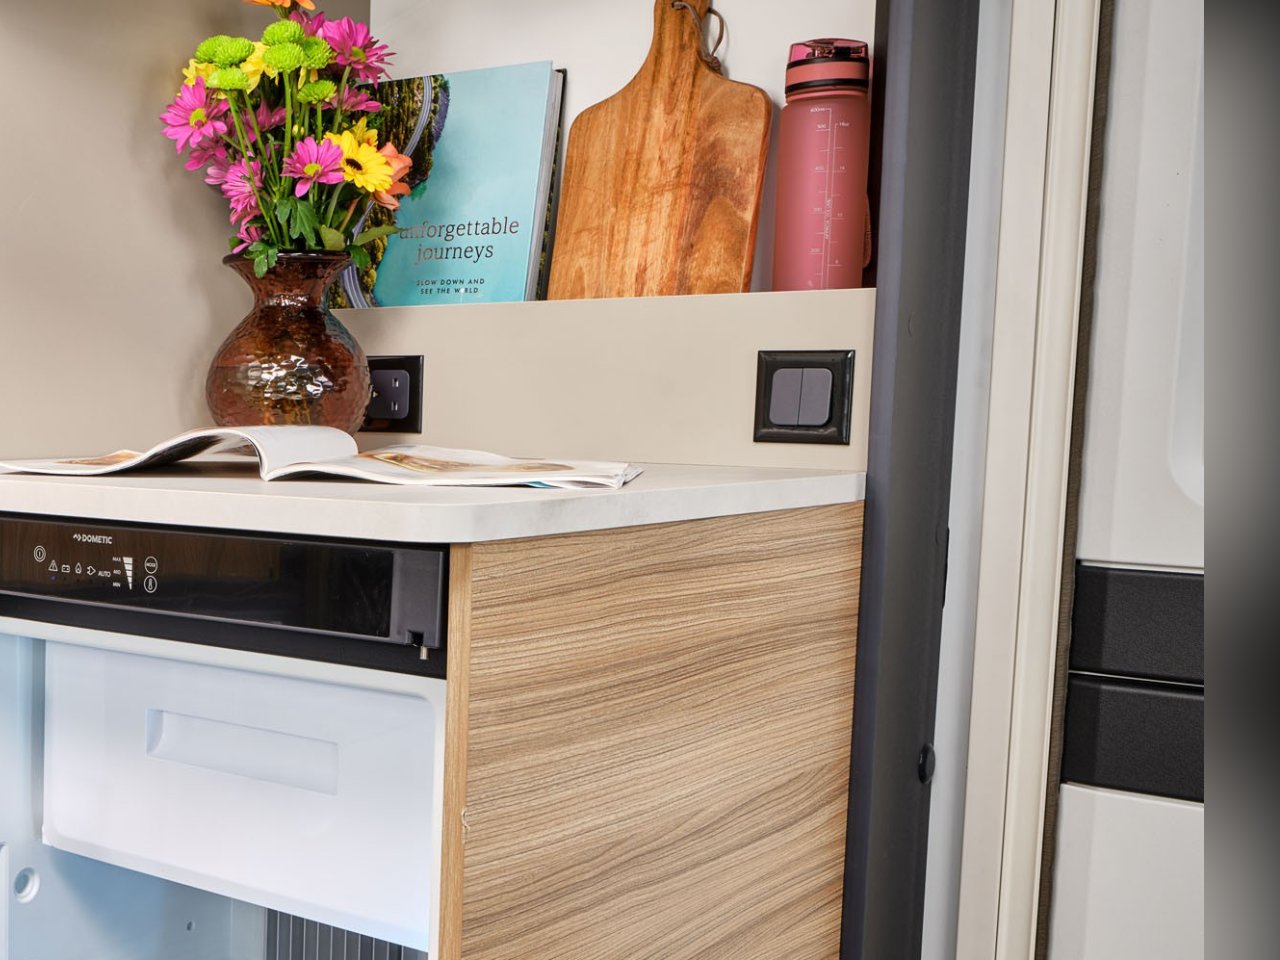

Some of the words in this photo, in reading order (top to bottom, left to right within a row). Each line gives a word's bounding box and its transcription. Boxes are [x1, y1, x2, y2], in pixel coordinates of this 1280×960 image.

[399, 216, 520, 242] unforgettable
[414, 243, 494, 265] journeys
[416, 279, 438, 287] SLOW
[440, 278, 465, 286] DOWN
[468, 277, 485, 285] AND
[420, 287, 433, 295] SEE
[454, 286, 479, 294] WRLD
[82, 534, 113, 544] DOMETIC
